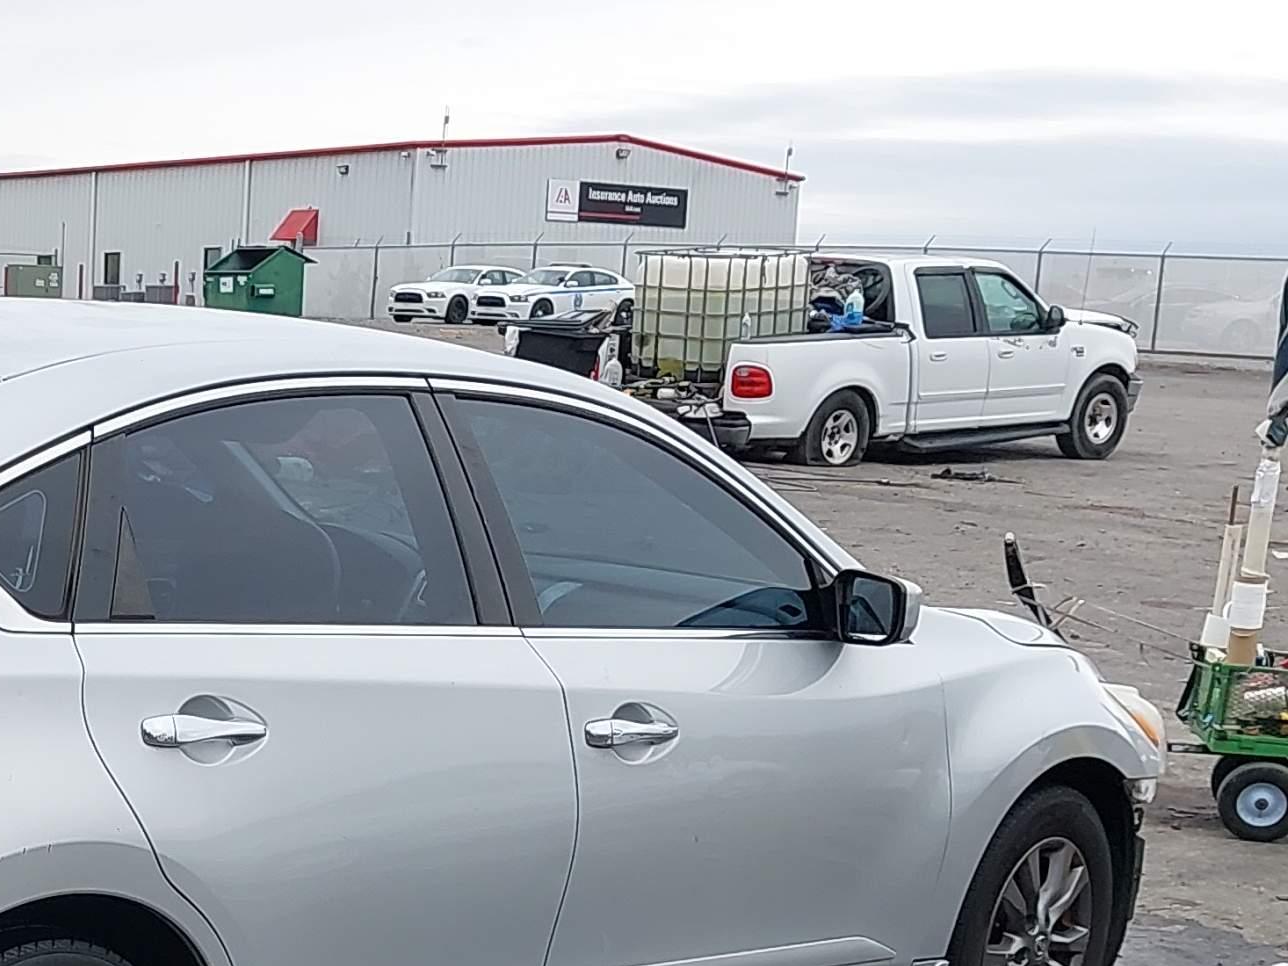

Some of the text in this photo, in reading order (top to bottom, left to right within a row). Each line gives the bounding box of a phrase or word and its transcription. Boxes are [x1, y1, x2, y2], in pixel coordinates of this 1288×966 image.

[588, 187, 678, 206] Insurance Auto Auctions
